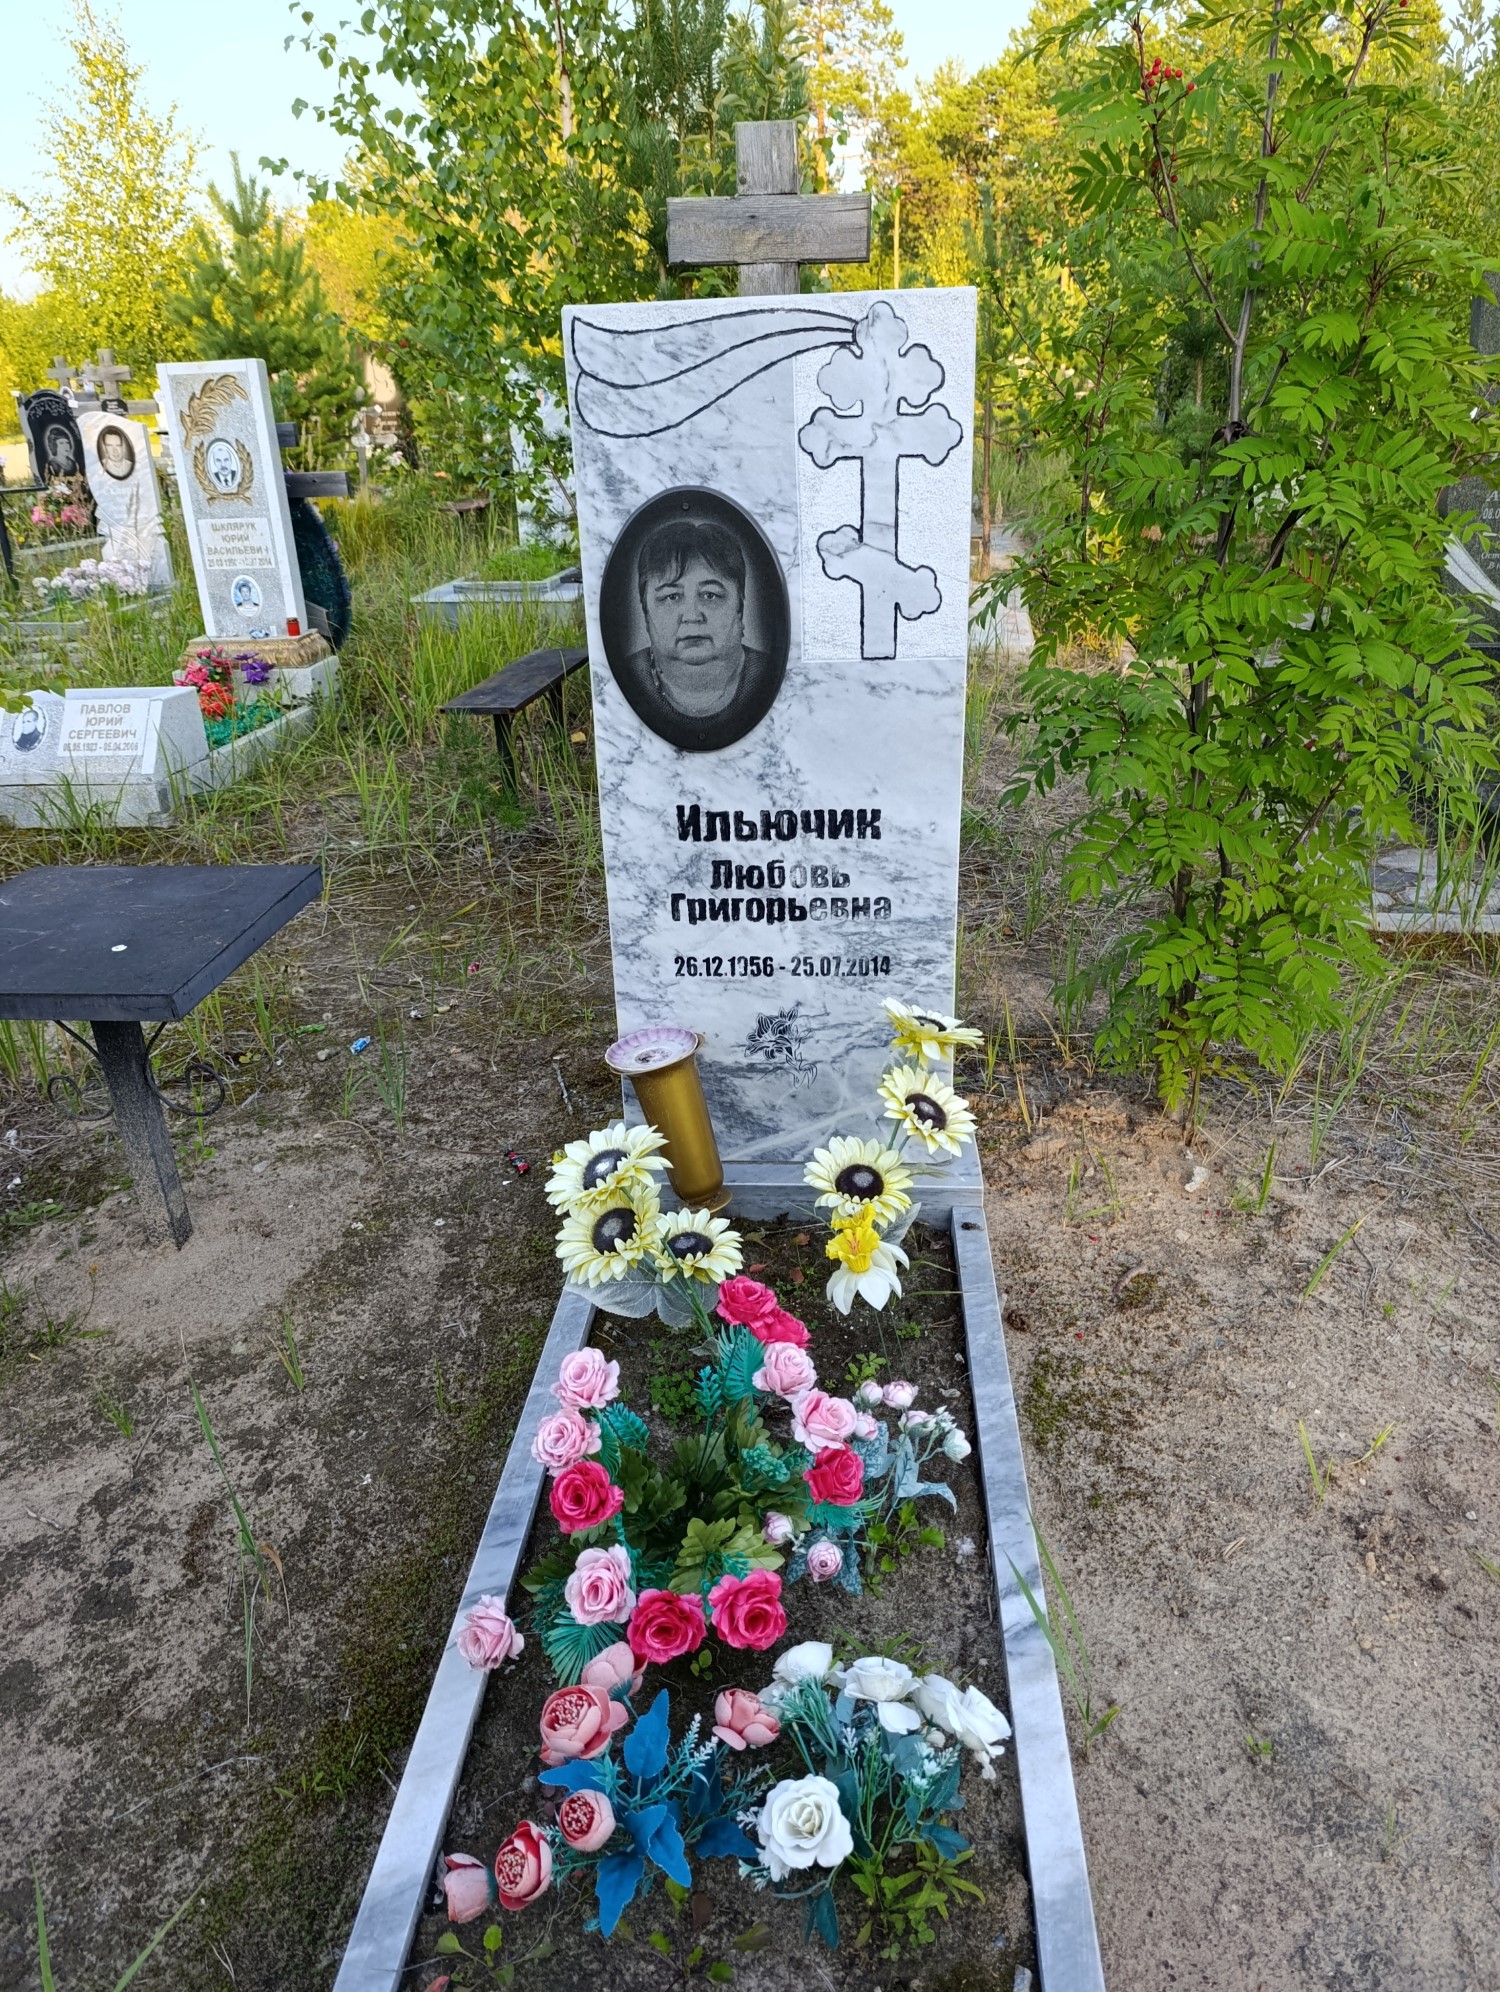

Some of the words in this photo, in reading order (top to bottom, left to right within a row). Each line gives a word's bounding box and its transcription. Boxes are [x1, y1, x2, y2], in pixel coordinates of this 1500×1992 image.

[80, 704, 131, 715] ПАВЛОВ
[86, 715, 123, 727] ЮРИЙ
[69, 729, 137, 740] СЕРГЕЕВИЧ
[676, 804, 882, 842] Ильючик
[710, 859, 851, 890] Любовь
[670, 892, 892, 925] Григорьевна
[674, 955, 774, 977] 26.12.1956
[790, 955, 891, 977] 25.07.2014
